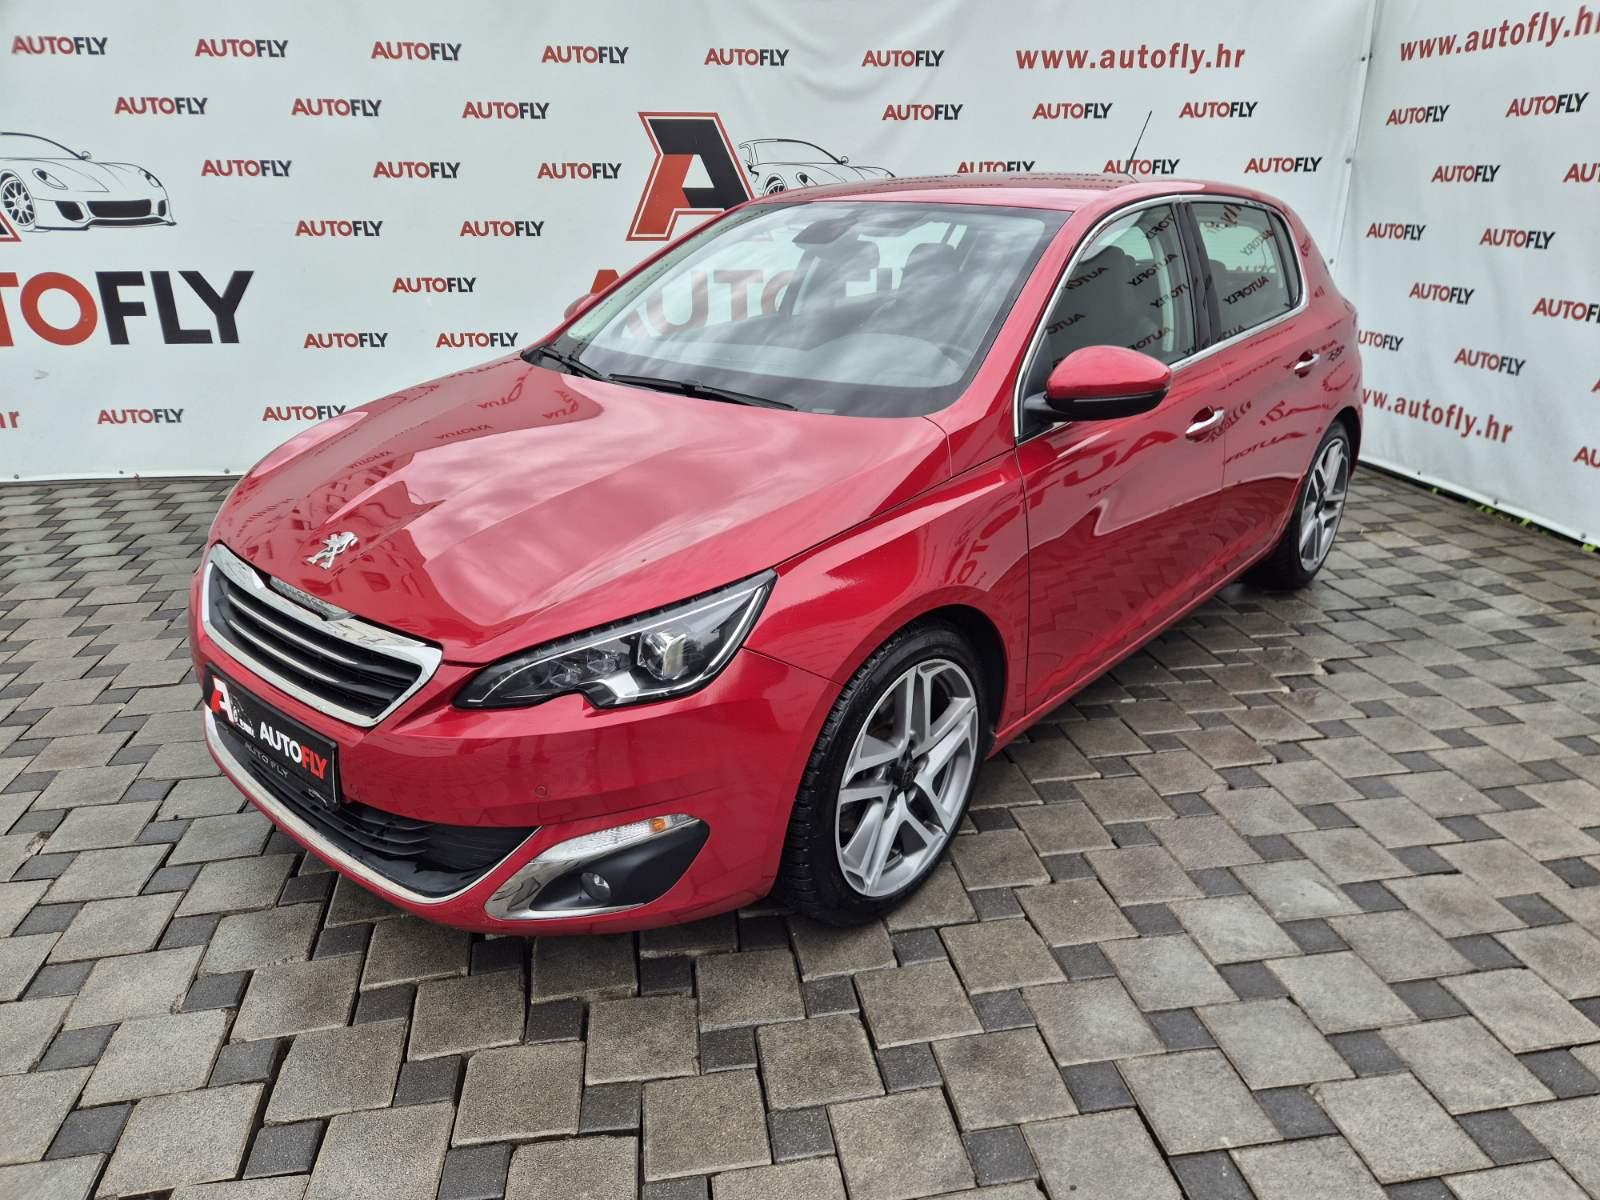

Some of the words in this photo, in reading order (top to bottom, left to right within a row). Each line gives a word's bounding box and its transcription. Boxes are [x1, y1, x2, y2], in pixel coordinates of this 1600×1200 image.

[12, 36, 108, 55] AUTOFLY
[195, 39, 288, 58] AUTOFLY
[371, 42, 462, 61] AUTOFLY
[542, 46, 629, 64] AUTOFLY
[704, 48, 789, 66] AUTOFLY
[862, 50, 944, 67] AUTOFLY
[1016, 43, 1245, 74] www.autofly.hr
[115, 97, 208, 115] AUTOFLY
[292, 98, 382, 117] AUTOFLY
[462, 102, 550, 119] AUTOFLY
[882, 104, 963, 120] AUTOFLY
[1032, 103, 1113, 119] AUTOFLY
[1179, 101, 1258, 118] AUTOFLY
[1505, 92, 1589, 118] AUTOFLY
[1386, 105, 1450, 125] AUTOFLY
[201, 160, 292, 177] AUTOFLY
[373, 162, 460, 179] AUTOFLY
[537, 163, 622, 179] AUTOFLY
[1103, 159, 1180, 175] AUTOFLY
[1244, 157, 1323, 173] AUTOFLY
[1432, 165, 1501, 182] AUTOFLY
[295, 220, 383, 236] AUTOFLY
[460, 221, 544, 236] AUTOFLY
[1366, 223, 1426, 241] AUTOFLY
[1480, 228, 1556, 250] AUTOFLY
[392, 277, 476, 293] AUTOFLY
[1409, 283, 1474, 305] AUTOFLY
[304, 333, 388, 348] AUTOFLY
[436, 332, 518, 348] AUTOFLY
[1359, 330, 1404, 351] UTOFLY
[1454, 349, 1526, 376] AUTOFLY
[97, 409, 184, 424] AUTOFLY
[262, 405, 346, 421] AUTOFLY
[260, 721, 328, 780] AUTOFLY
